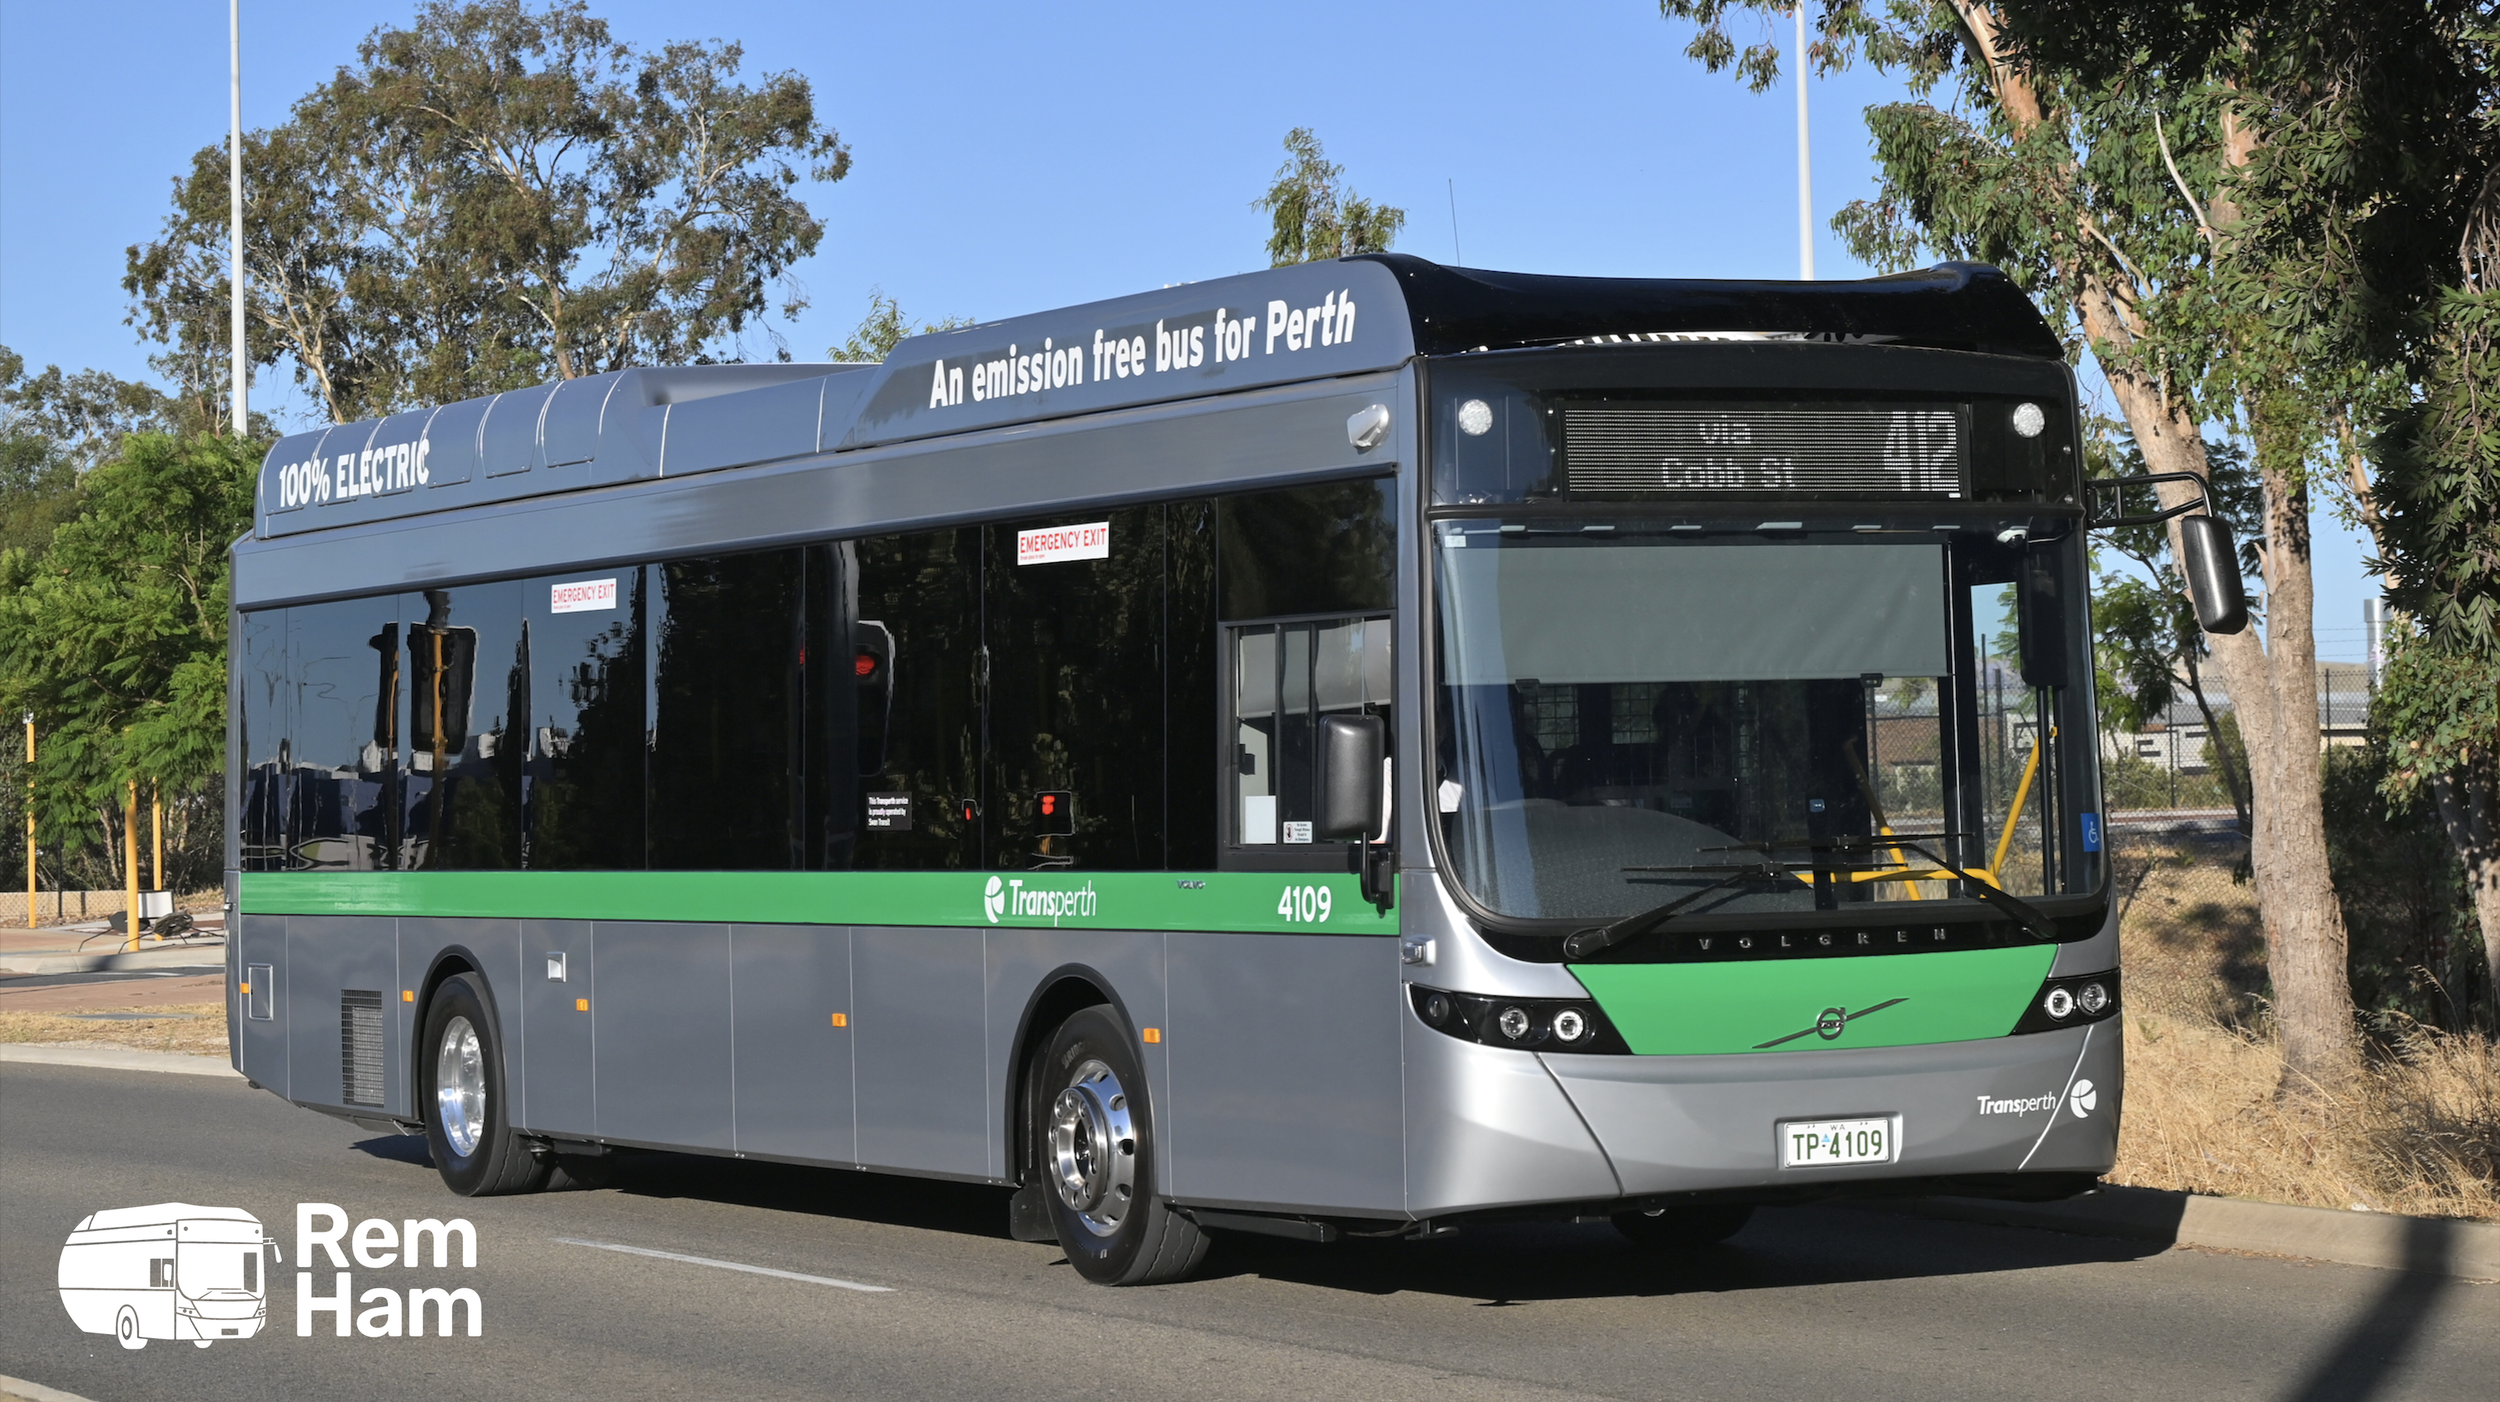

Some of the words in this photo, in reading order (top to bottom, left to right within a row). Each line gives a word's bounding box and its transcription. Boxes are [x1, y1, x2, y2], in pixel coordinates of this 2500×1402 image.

[929, 359, 963, 409] An
[972, 337, 1083, 402] emission
[1093, 329, 1146, 382] free
[1156, 319, 1204, 373] bus
[1215, 308, 1256, 363] for
[1266, 288, 1356, 354] Perth
[1700, 415, 1750, 445] via
[1883, 410, 1959, 492] 412
[279, 457, 331, 508] 100%
[336, 438, 430, 499] ELECTRIC
[1662, 458, 1745, 488] Cobb
[1760, 458, 1796, 488] St
[1020, 531, 1081, 553] EMERGENCY
[1084, 528, 1107, 547] EXIT
[553, 586, 597, 604] EMERGENCY
[598, 583, 615, 599] EXIT
[1009, 880, 1097, 928] Transperth
[1277, 885, 1332, 923] 4109
[1699, 928, 1946, 950] VOLGREN
[1977, 1091, 2057, 1118] Transperth
